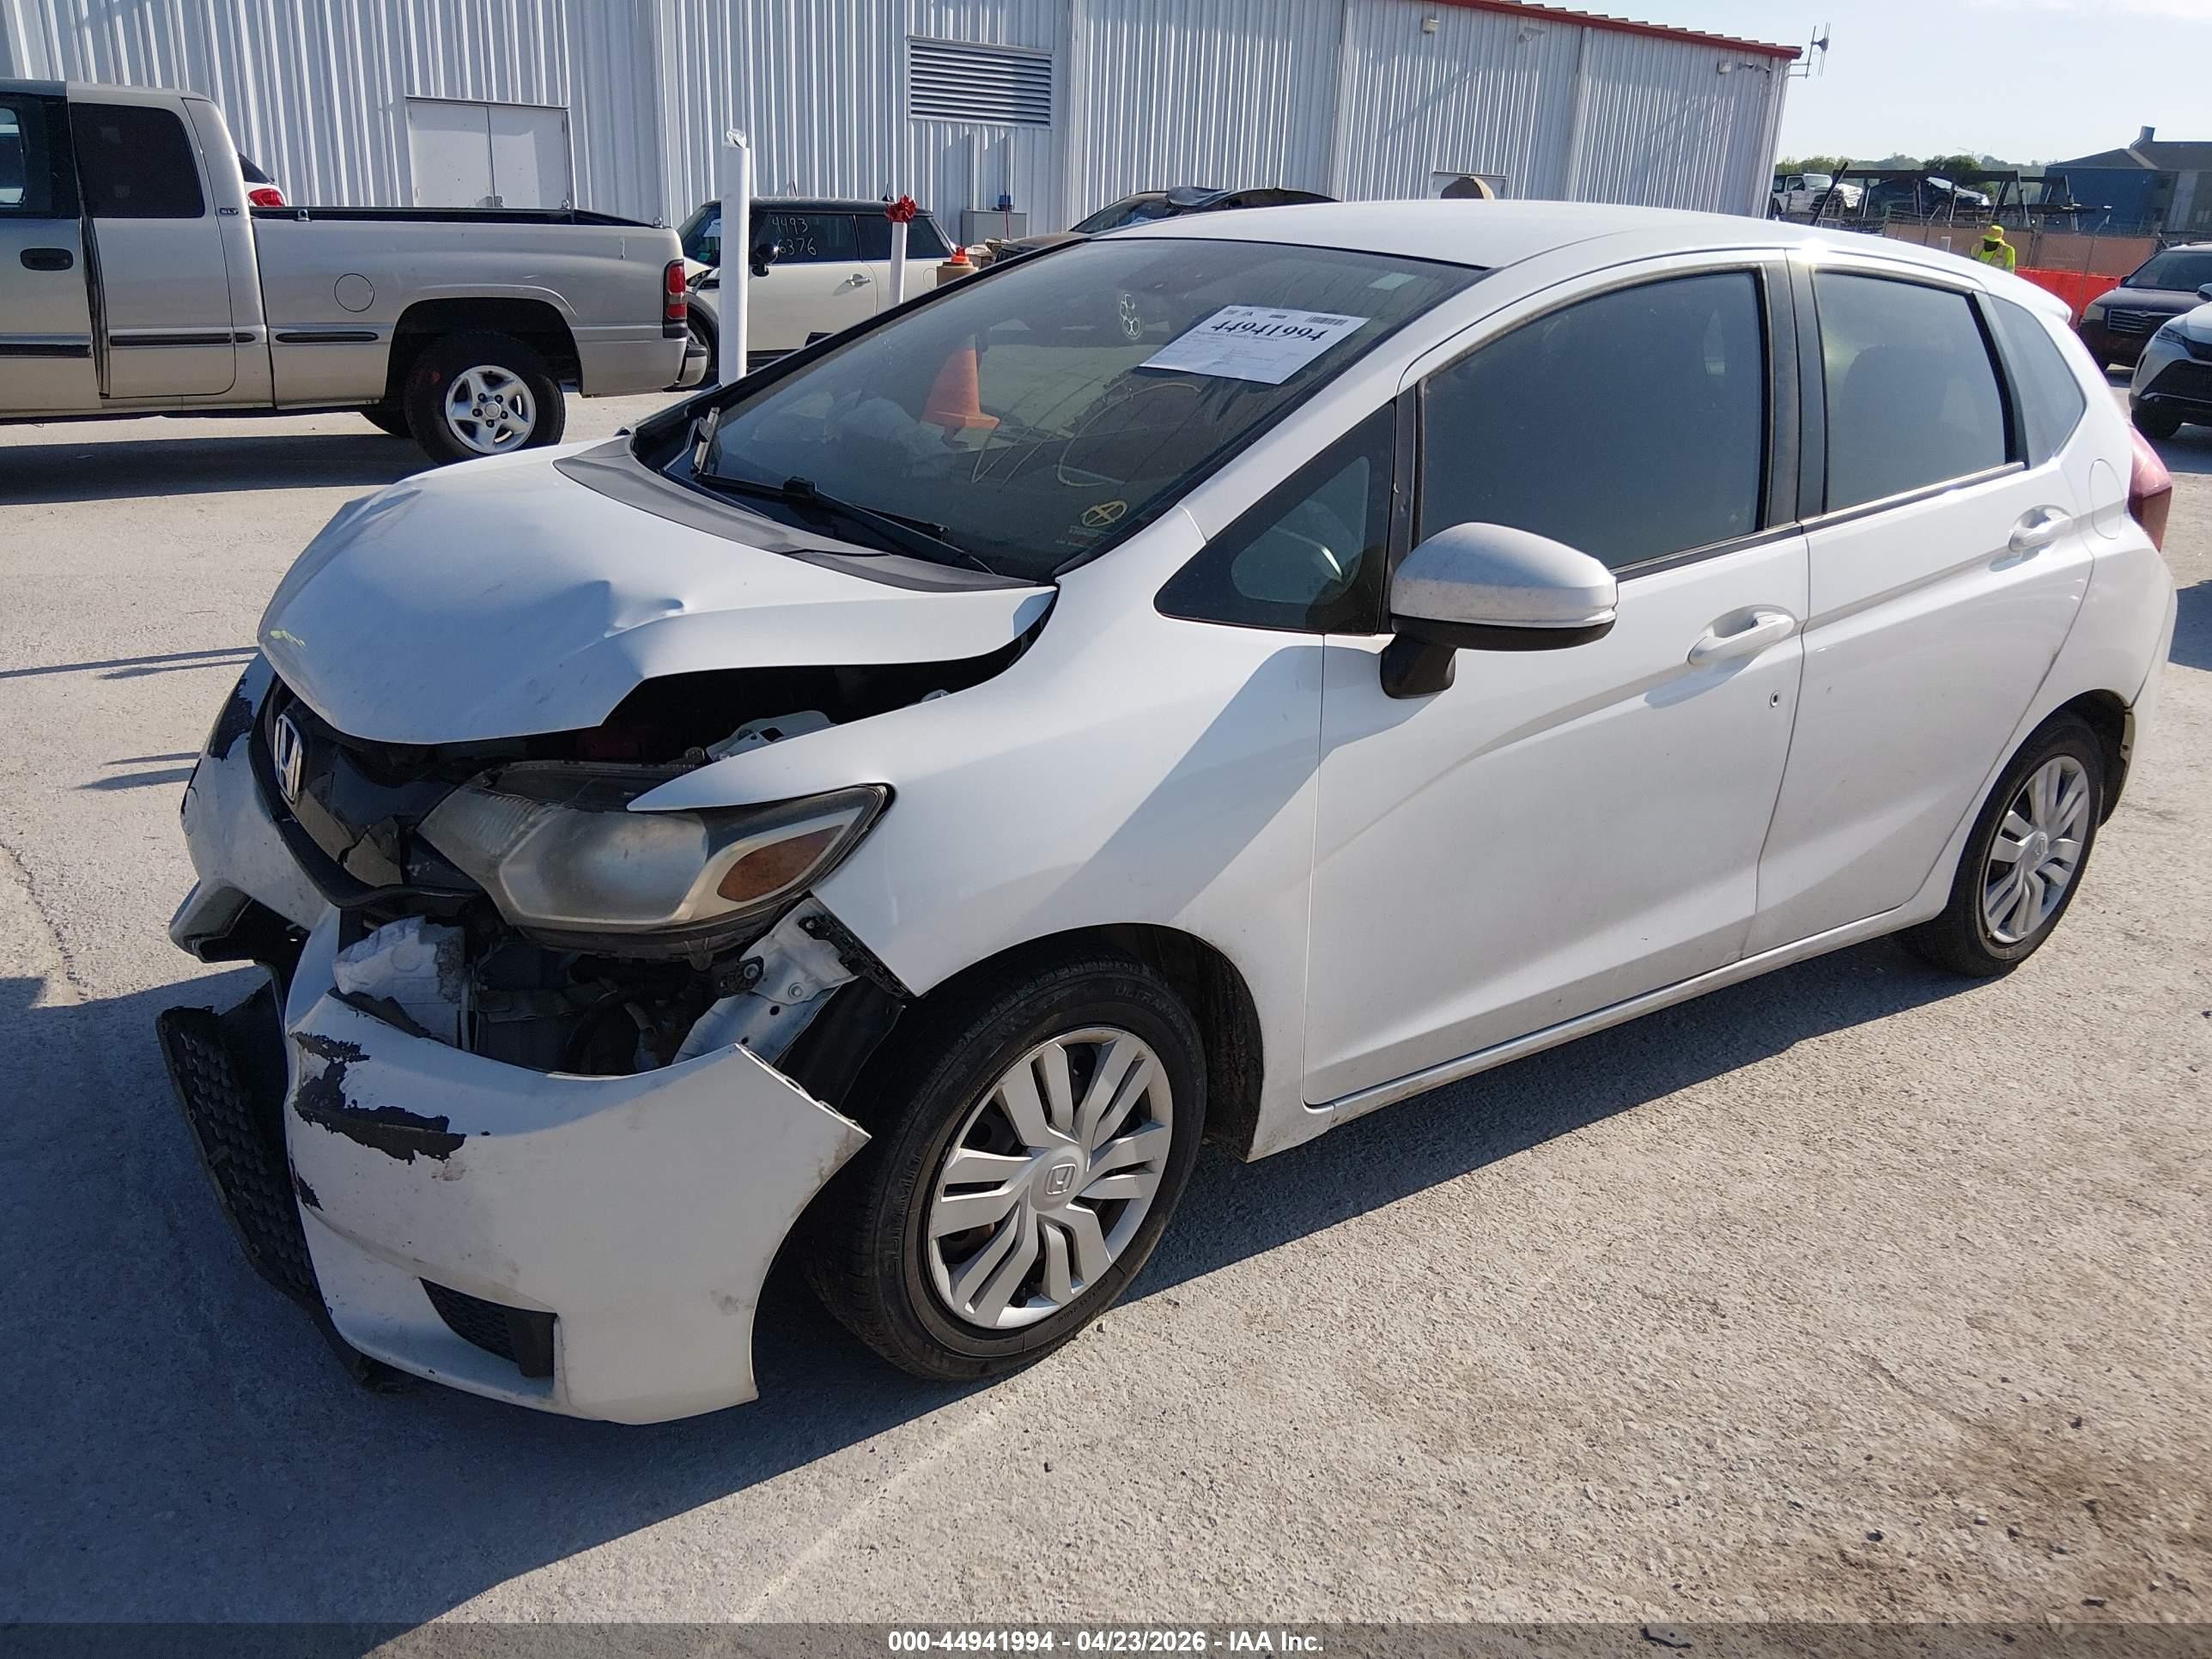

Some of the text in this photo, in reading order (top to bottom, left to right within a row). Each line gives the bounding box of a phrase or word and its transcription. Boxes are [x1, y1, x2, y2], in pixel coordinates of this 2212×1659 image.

[772, 216, 808, 235] 4493
[776, 237, 817, 256] 6376
[1211, 319, 1329, 342] 44941994
